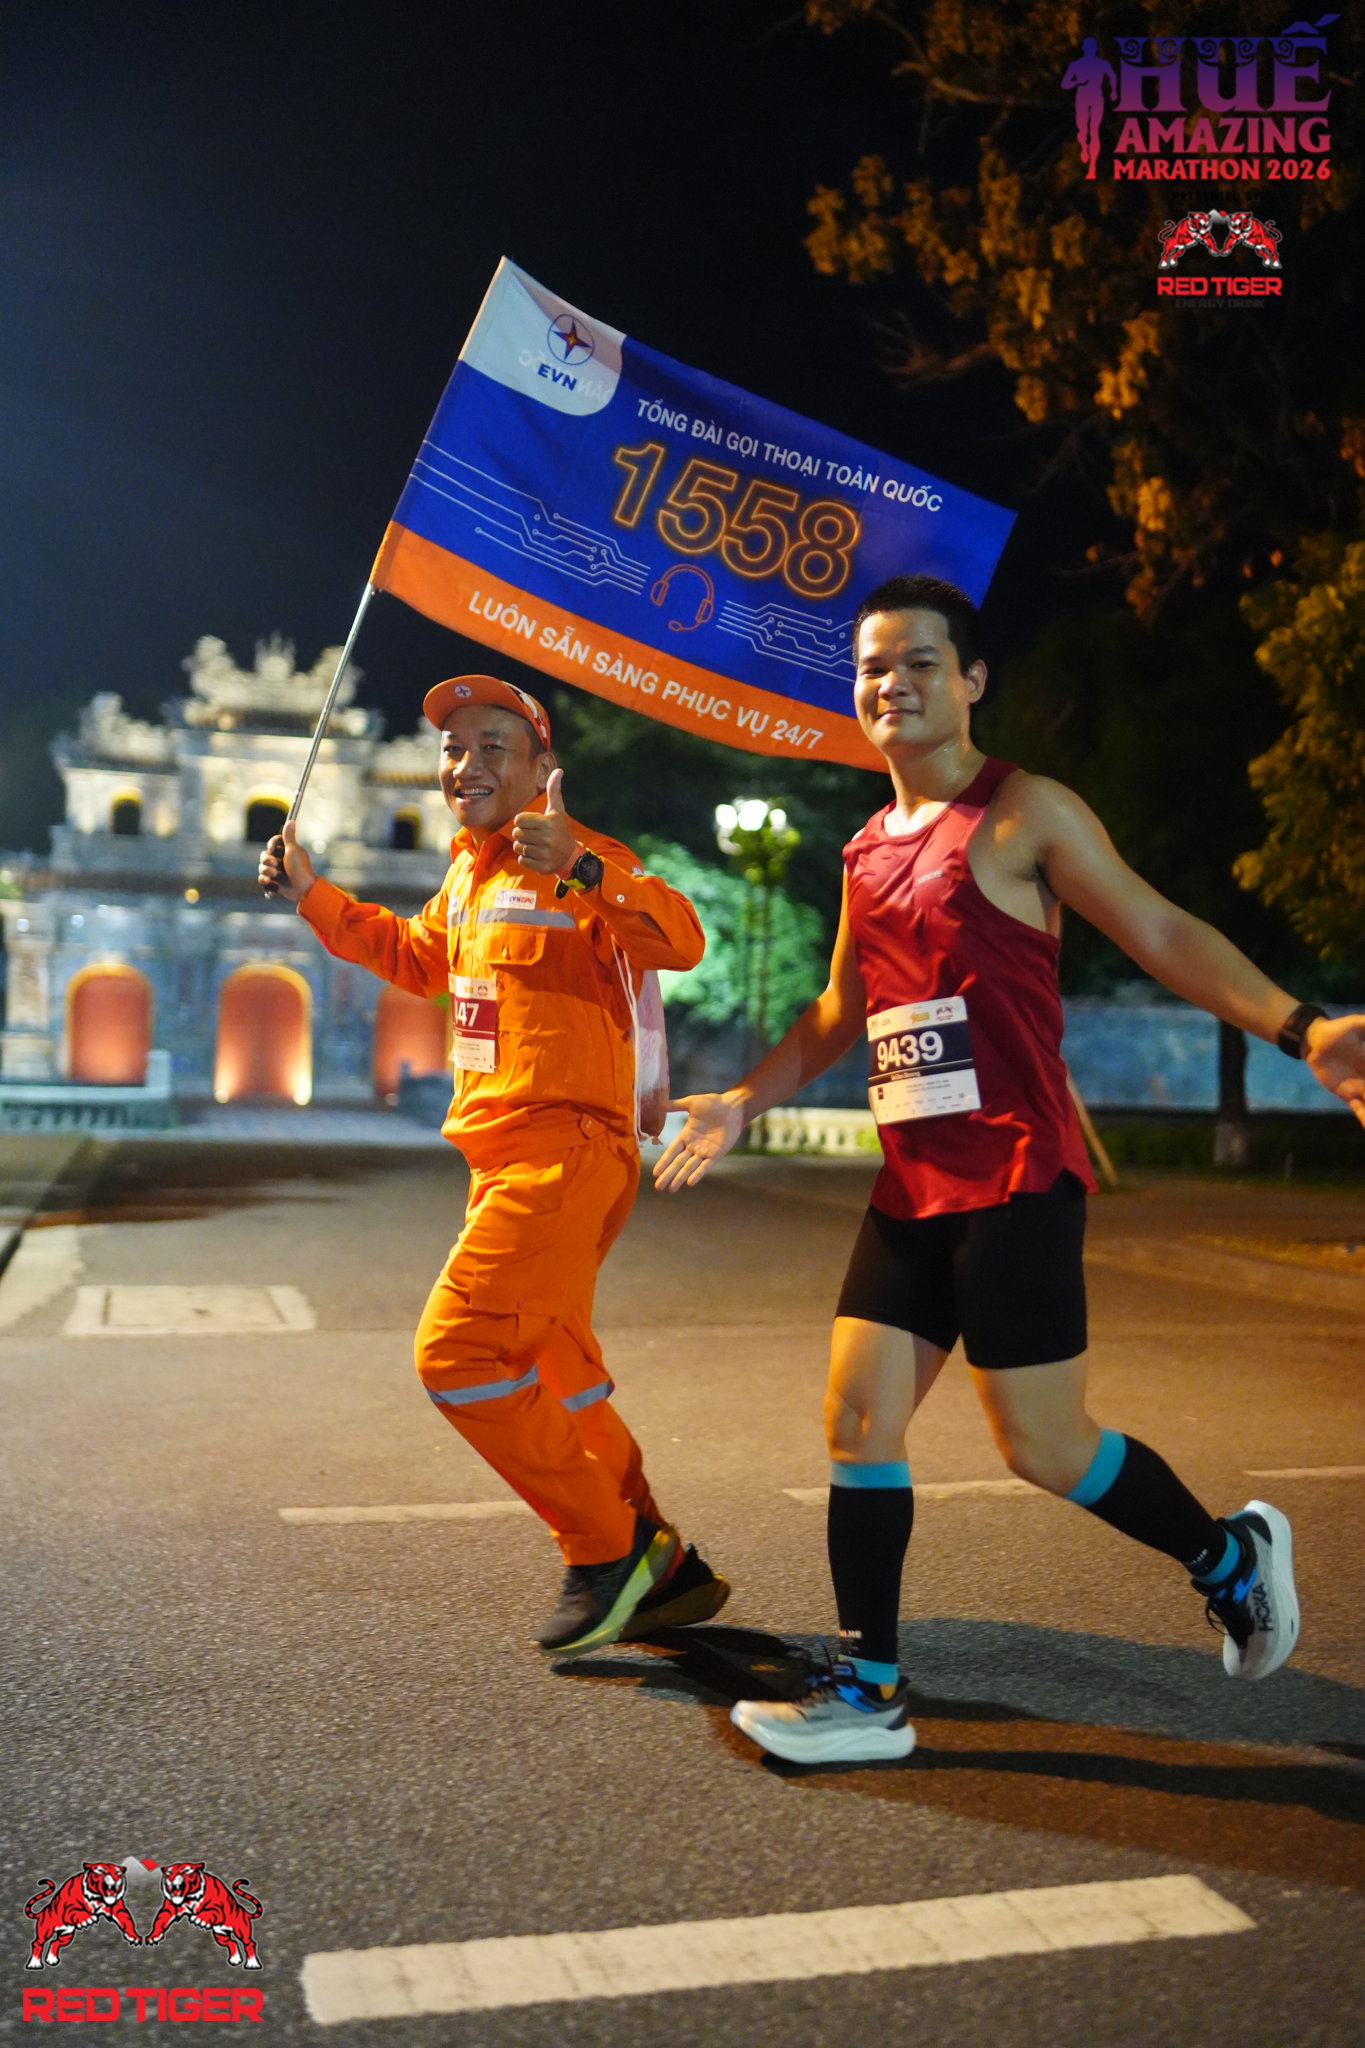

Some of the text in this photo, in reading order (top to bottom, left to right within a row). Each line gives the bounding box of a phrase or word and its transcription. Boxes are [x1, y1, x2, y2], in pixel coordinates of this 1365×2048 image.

[537, 363, 578, 391] EVN
[636, 398, 944, 513] TỔNG ĐÀI GỌI THOẠI TOÀN QUỐC
[614, 442, 862, 598] 1558
[468, 590, 824, 750] LUÔN SẴN SÀNG PHỤC VỤ 24/7
[877, 1030, 944, 1072] 9439
[1253, 1582, 1273, 1631] HOKA
